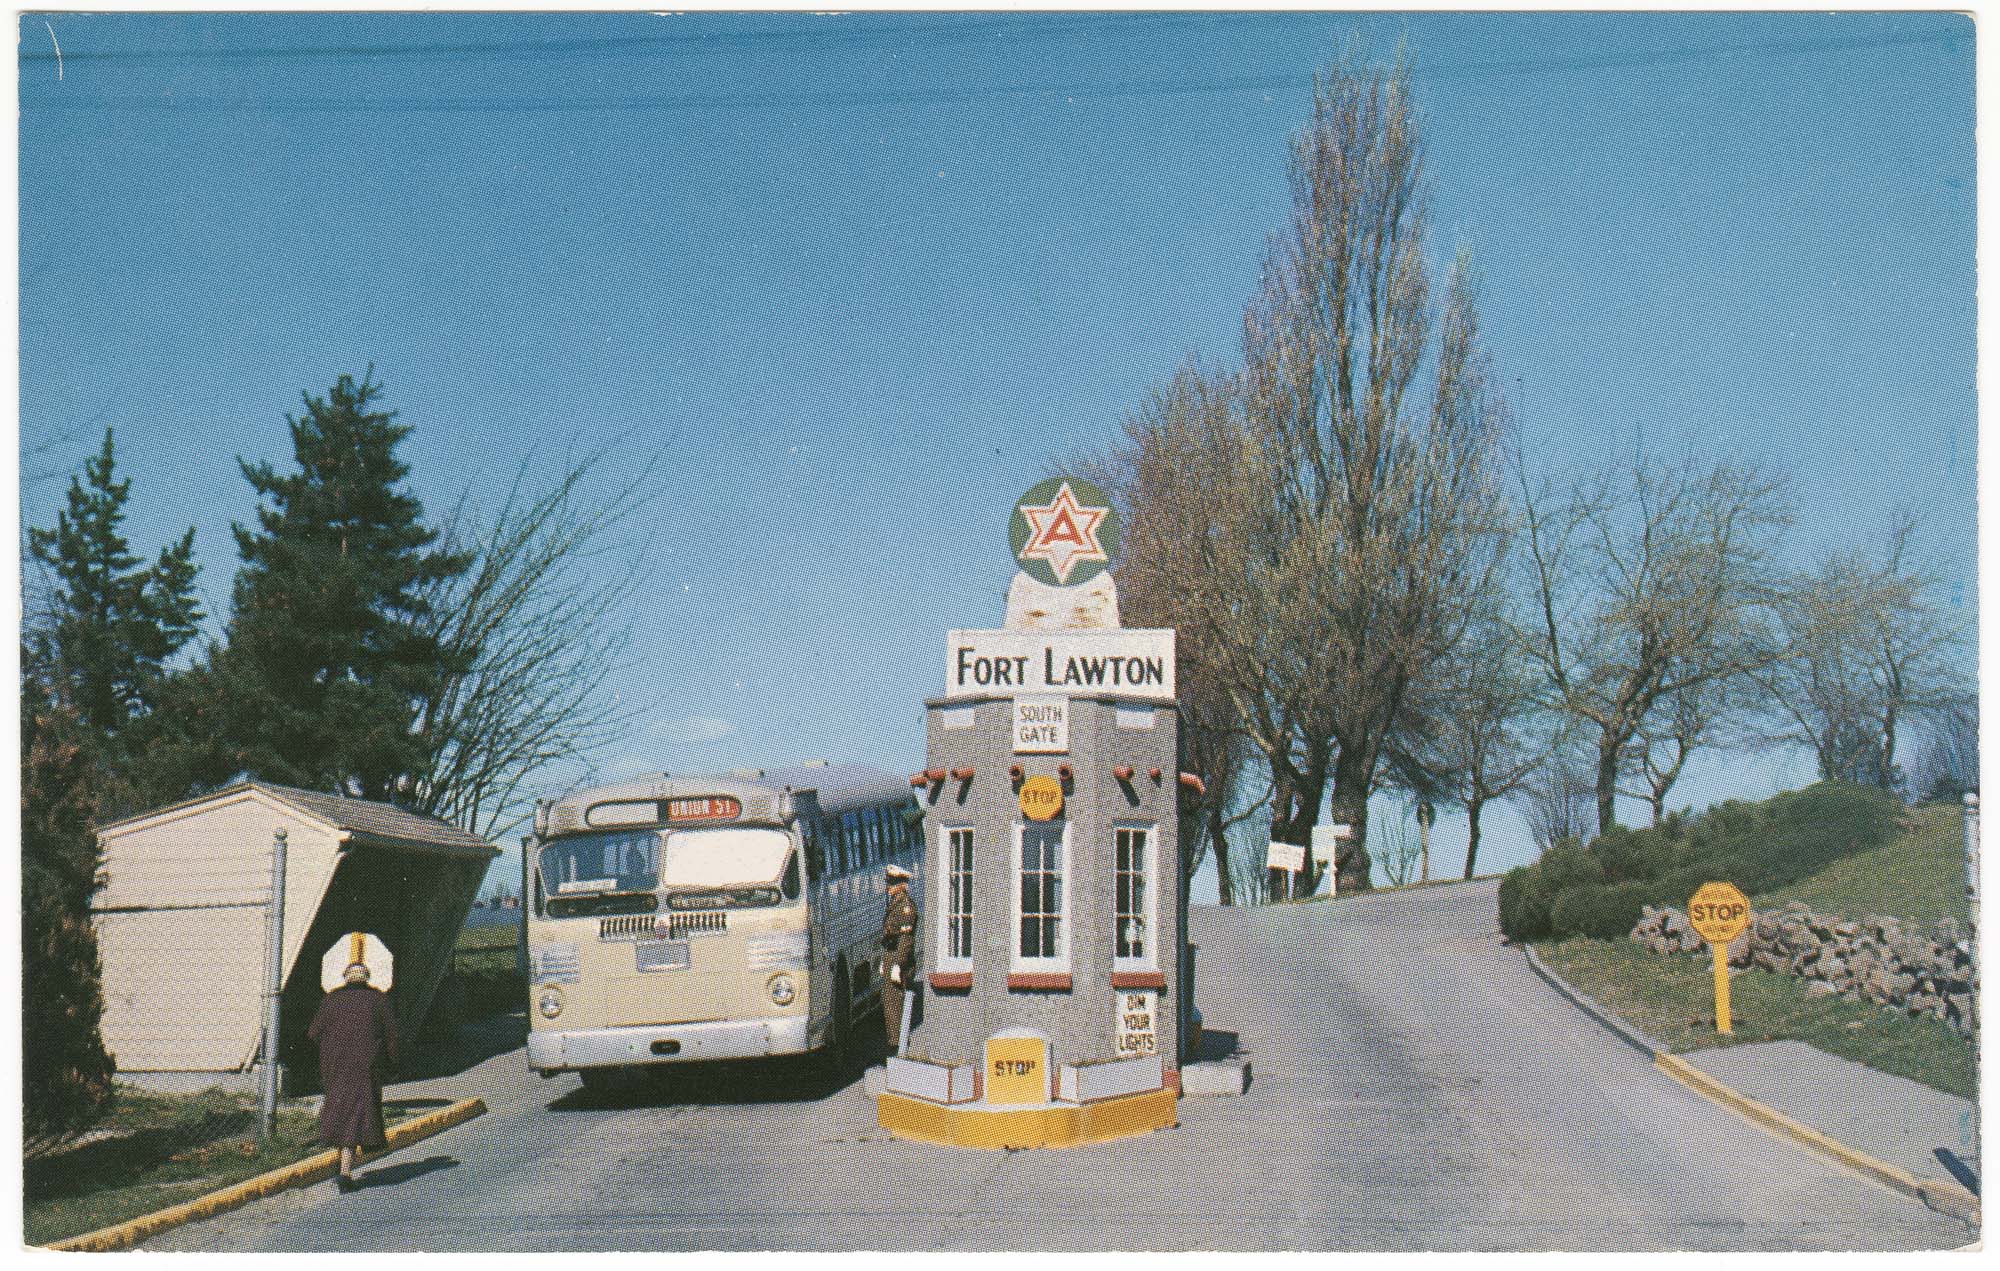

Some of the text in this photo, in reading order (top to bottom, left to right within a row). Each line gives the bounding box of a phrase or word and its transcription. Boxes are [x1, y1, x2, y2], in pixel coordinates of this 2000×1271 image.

[1040, 506, 1084, 546] A
[957, 646, 1163, 686] FORT LAWTON
[1020, 704, 1062, 721] SOUTH
[1020, 724, 1058, 743] GATE
[1022, 789, 1057, 804] STOP
[1693, 902, 1744, 921] STOP
[1122, 1013, 1150, 1030] YOUR
[1119, 1032, 1154, 1051] LIGHTS
[994, 1059, 1036, 1077] STOP
